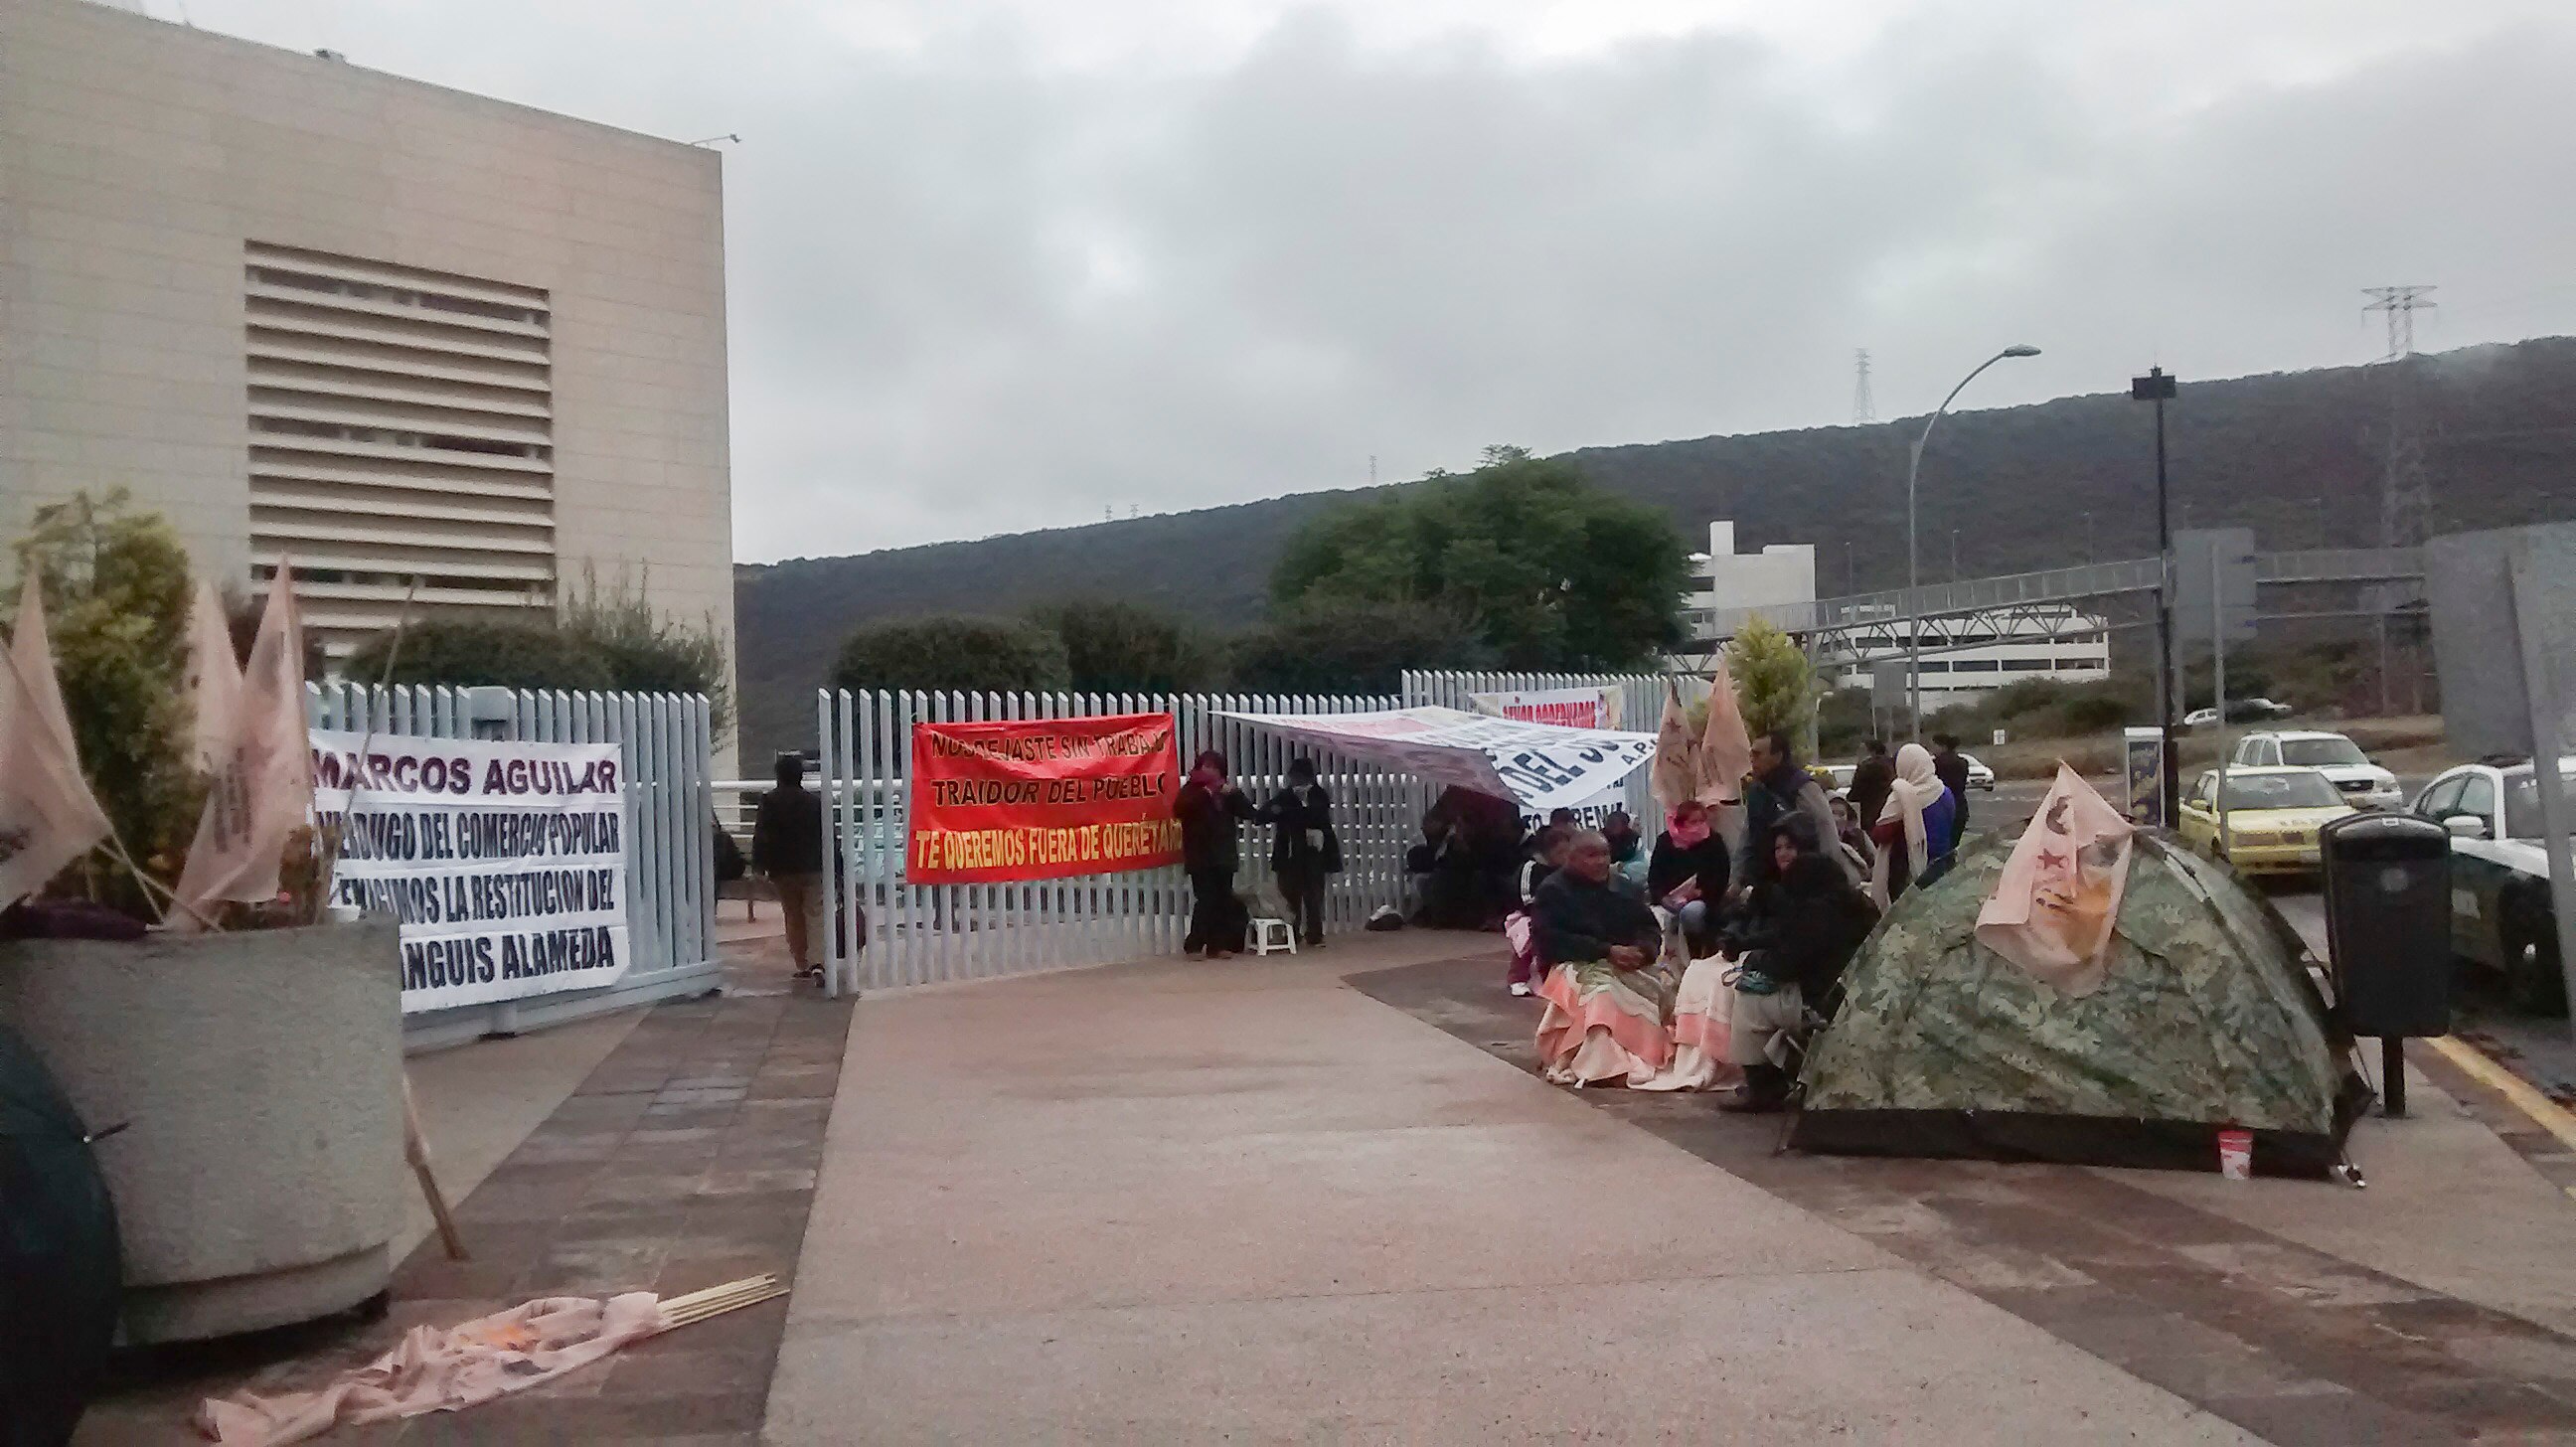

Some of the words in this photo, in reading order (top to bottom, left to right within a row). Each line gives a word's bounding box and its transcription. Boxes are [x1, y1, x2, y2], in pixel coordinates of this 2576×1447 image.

[312, 748, 472, 796] MARCOS
[482, 758, 618, 796] AGUILAR
[931, 778, 1042, 807] TRAIDOR
[1046, 777, 1087, 805] DEL
[418, 811, 454, 862] DEL
[455, 811, 546, 860] COMERCIO
[548, 810, 620, 858] POPULAR
[914, 829, 940, 870] TE
[943, 826, 1025, 872] QUEREMOS
[1028, 822, 1077, 866] FUERA
[1079, 821, 1100, 862] DE
[443, 874, 470, 923] LA
[471, 870, 584, 921] RESTITUCION
[586, 867, 616, 912] DEL
[501, 924, 616, 982] ALAMEDA
